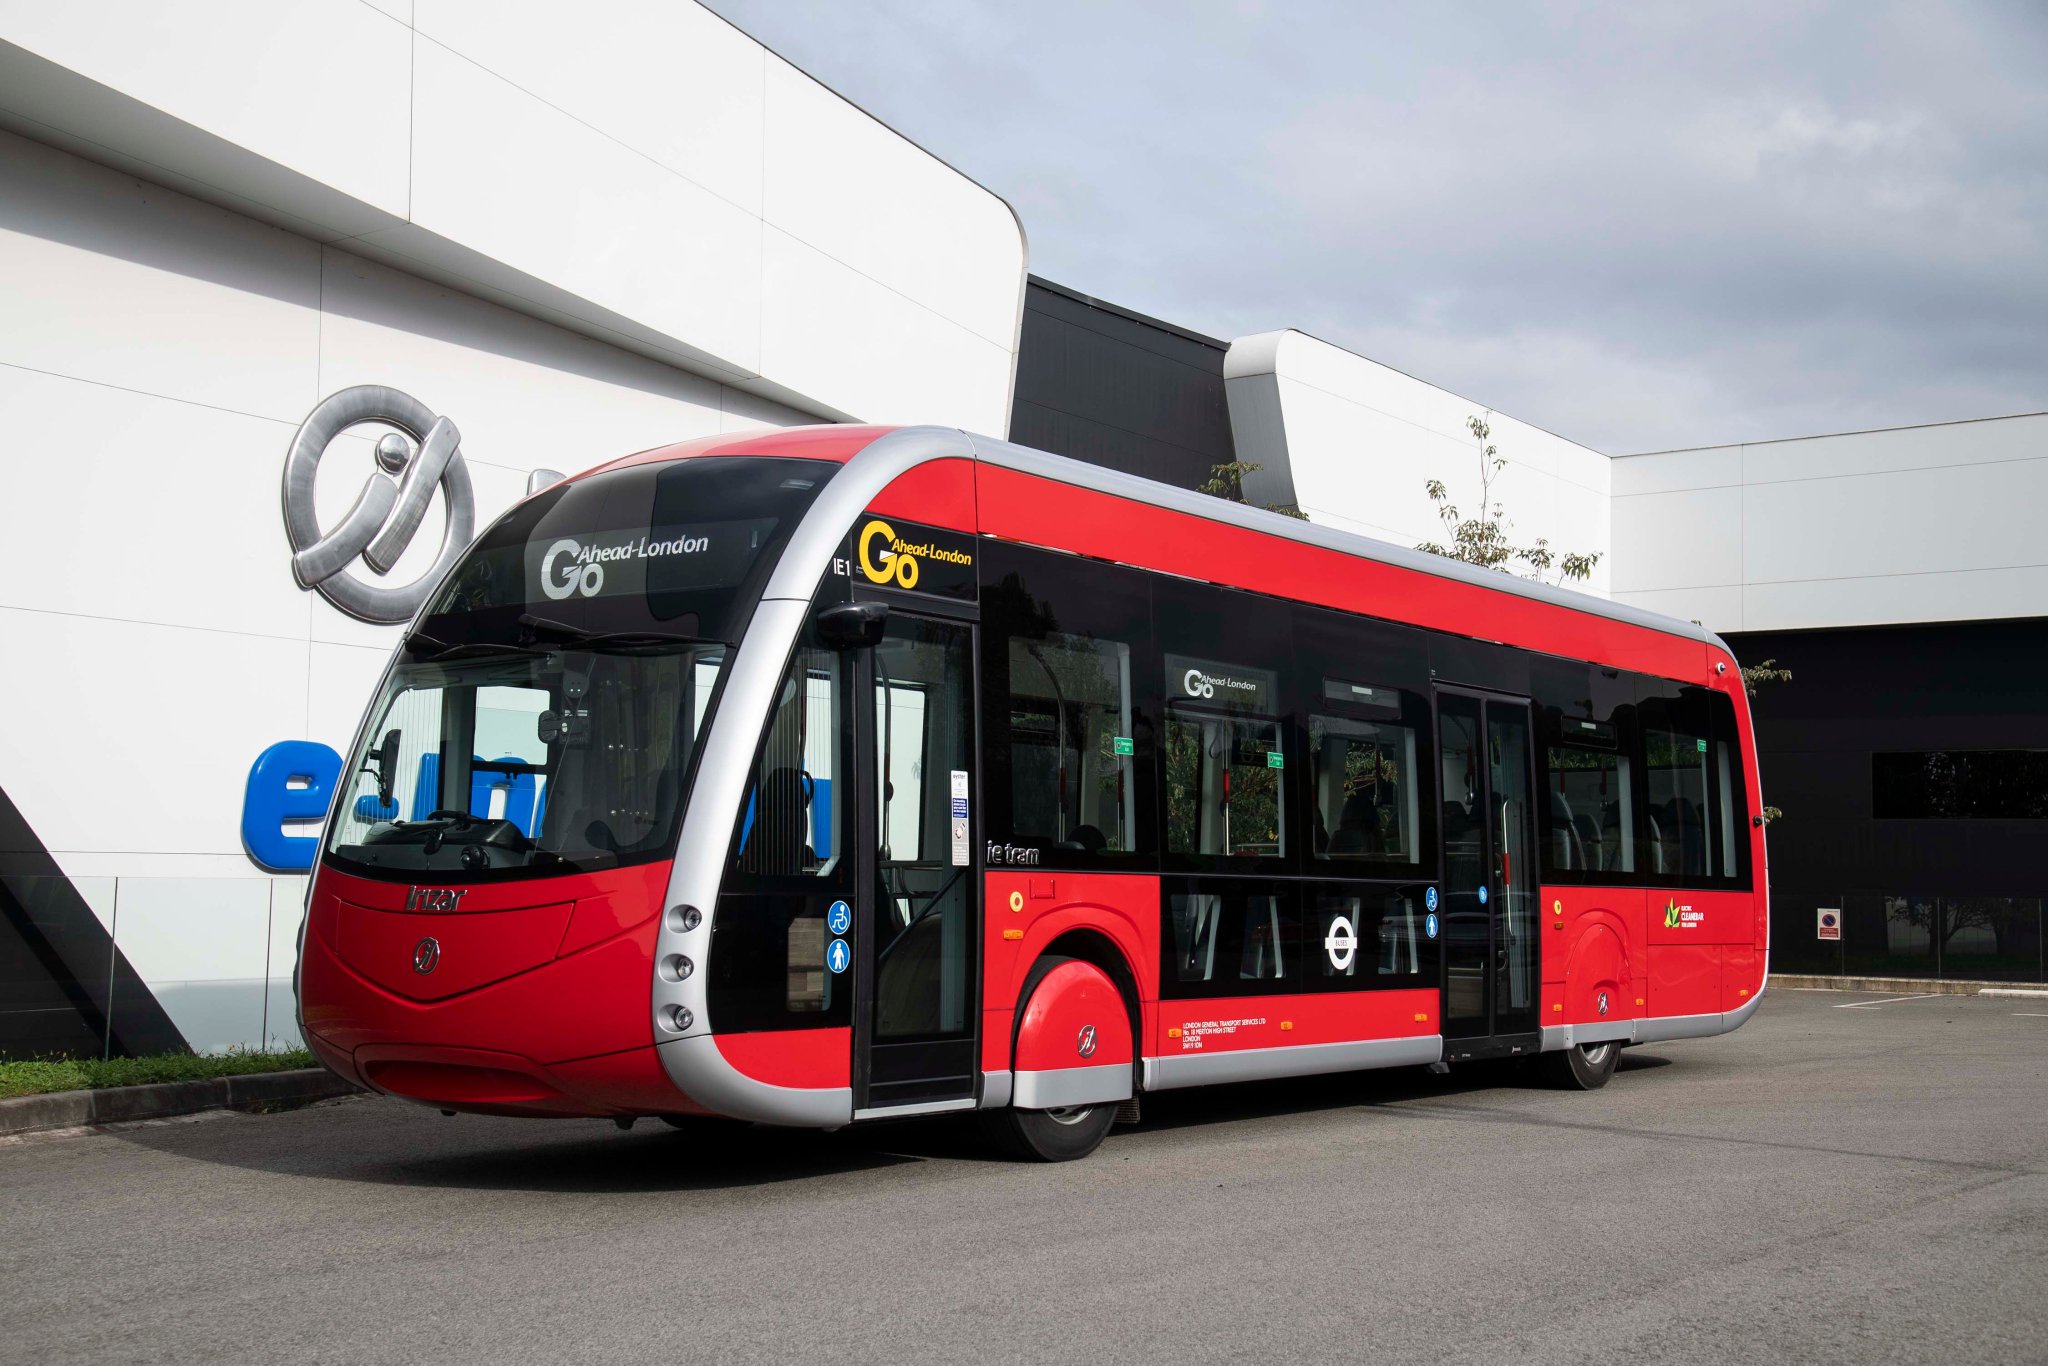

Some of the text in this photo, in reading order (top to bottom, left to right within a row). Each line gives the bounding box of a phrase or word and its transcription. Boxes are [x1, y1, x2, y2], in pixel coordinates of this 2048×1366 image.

[859, 520, 972, 589] Go Ahead-London
[541, 534, 709, 600] Go Ahead-London
[833, 557, 850, 577] IE1
[1184, 669, 1256, 699] Go Ahead-London
[986, 840, 1003, 863] ie
[1005, 843, 1040, 864] tram
[1223, 1026, 1236, 1034] STREET
[1241, 1018, 1258, 1026] SERVICES
[1182, 1035, 1201, 1043] LONDON
